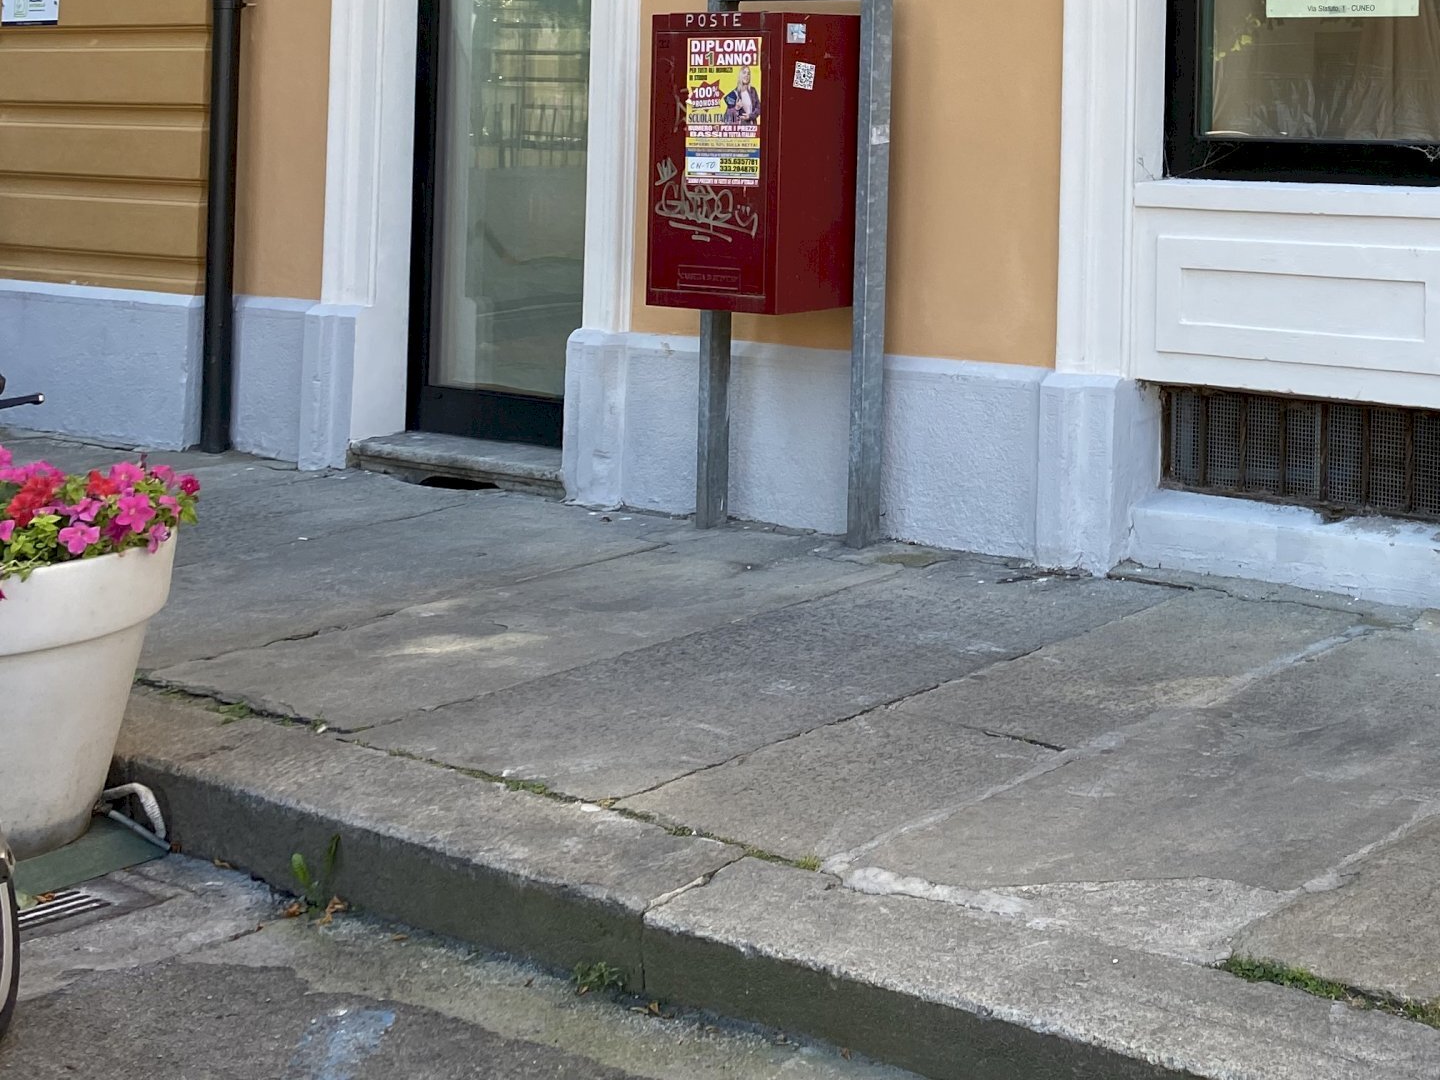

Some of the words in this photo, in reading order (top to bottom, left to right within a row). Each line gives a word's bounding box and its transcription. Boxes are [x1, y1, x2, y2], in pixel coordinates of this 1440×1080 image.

[685, 13, 743, 28] POSTE
[691, 39, 757, 53] DIPLOMA
[690, 53, 704, 66] IN
[705, 51, 715, 67] 1
[693, 85, 720, 99] 100%
[688, 113, 711, 123] SCUOLA
